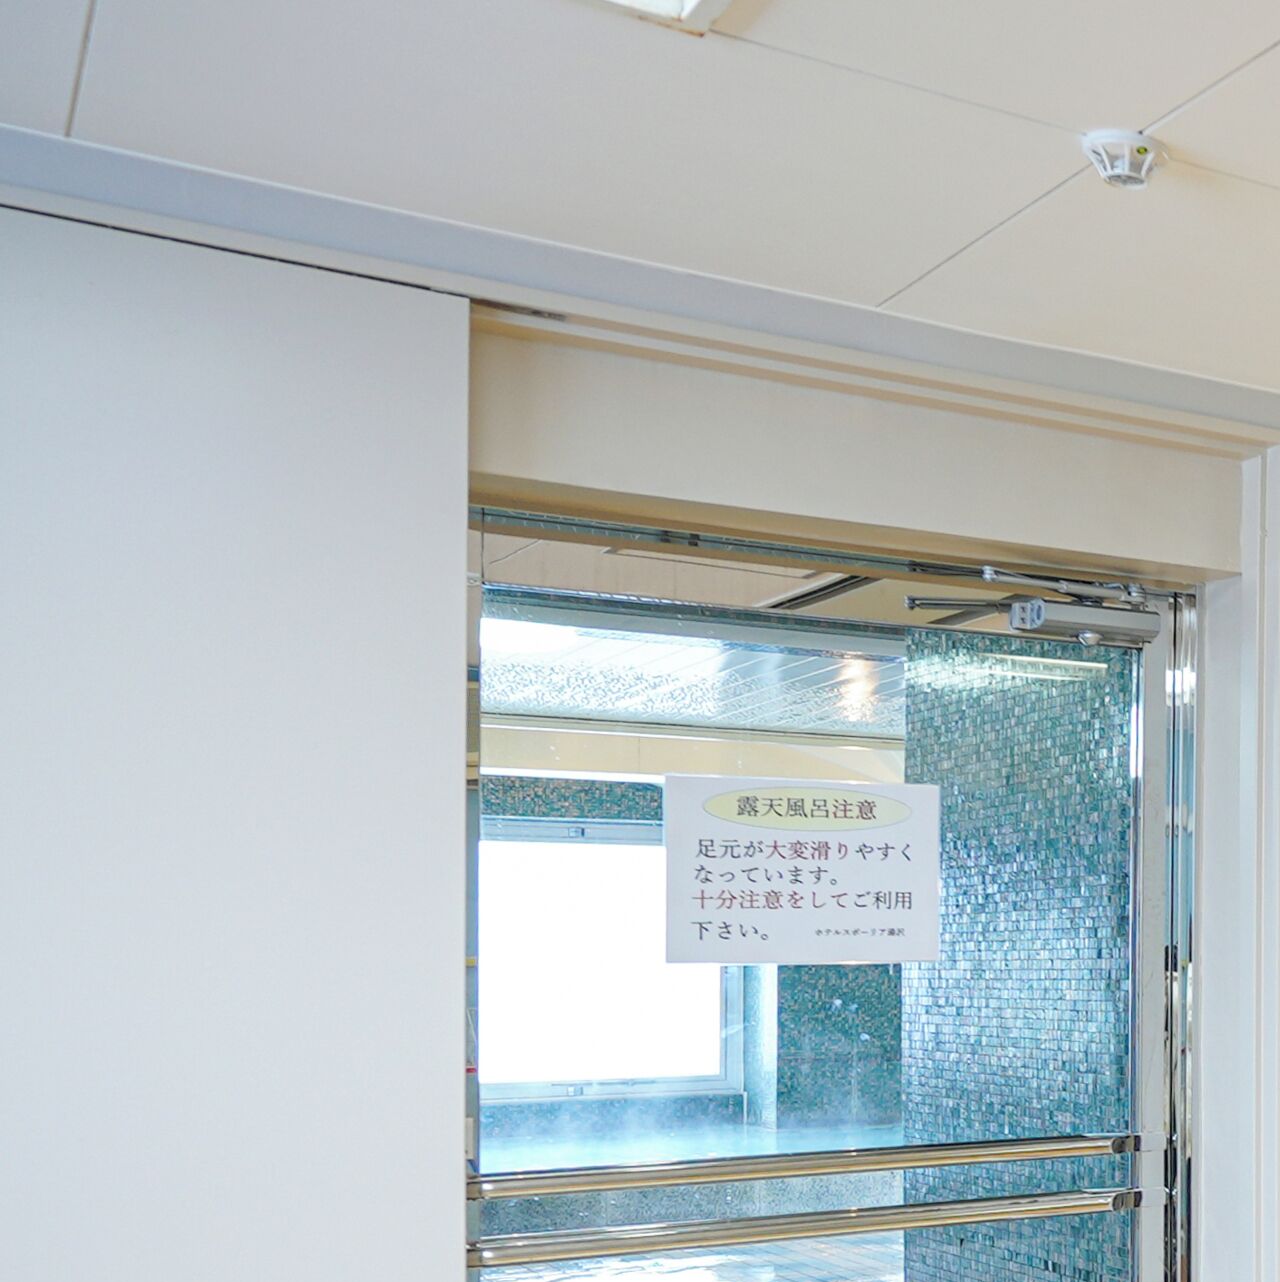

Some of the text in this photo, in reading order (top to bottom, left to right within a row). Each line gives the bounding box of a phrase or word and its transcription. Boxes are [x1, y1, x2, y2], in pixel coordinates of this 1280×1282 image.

[736, 795, 877, 820] 露天風呂注意
[695, 838, 914, 862] 足元が大変滑りやすく
[693, 864, 839, 886] なっています。
[691, 889, 913, 911] 十分注意をしてご利用
[690, 920, 770, 942] 下さい。
